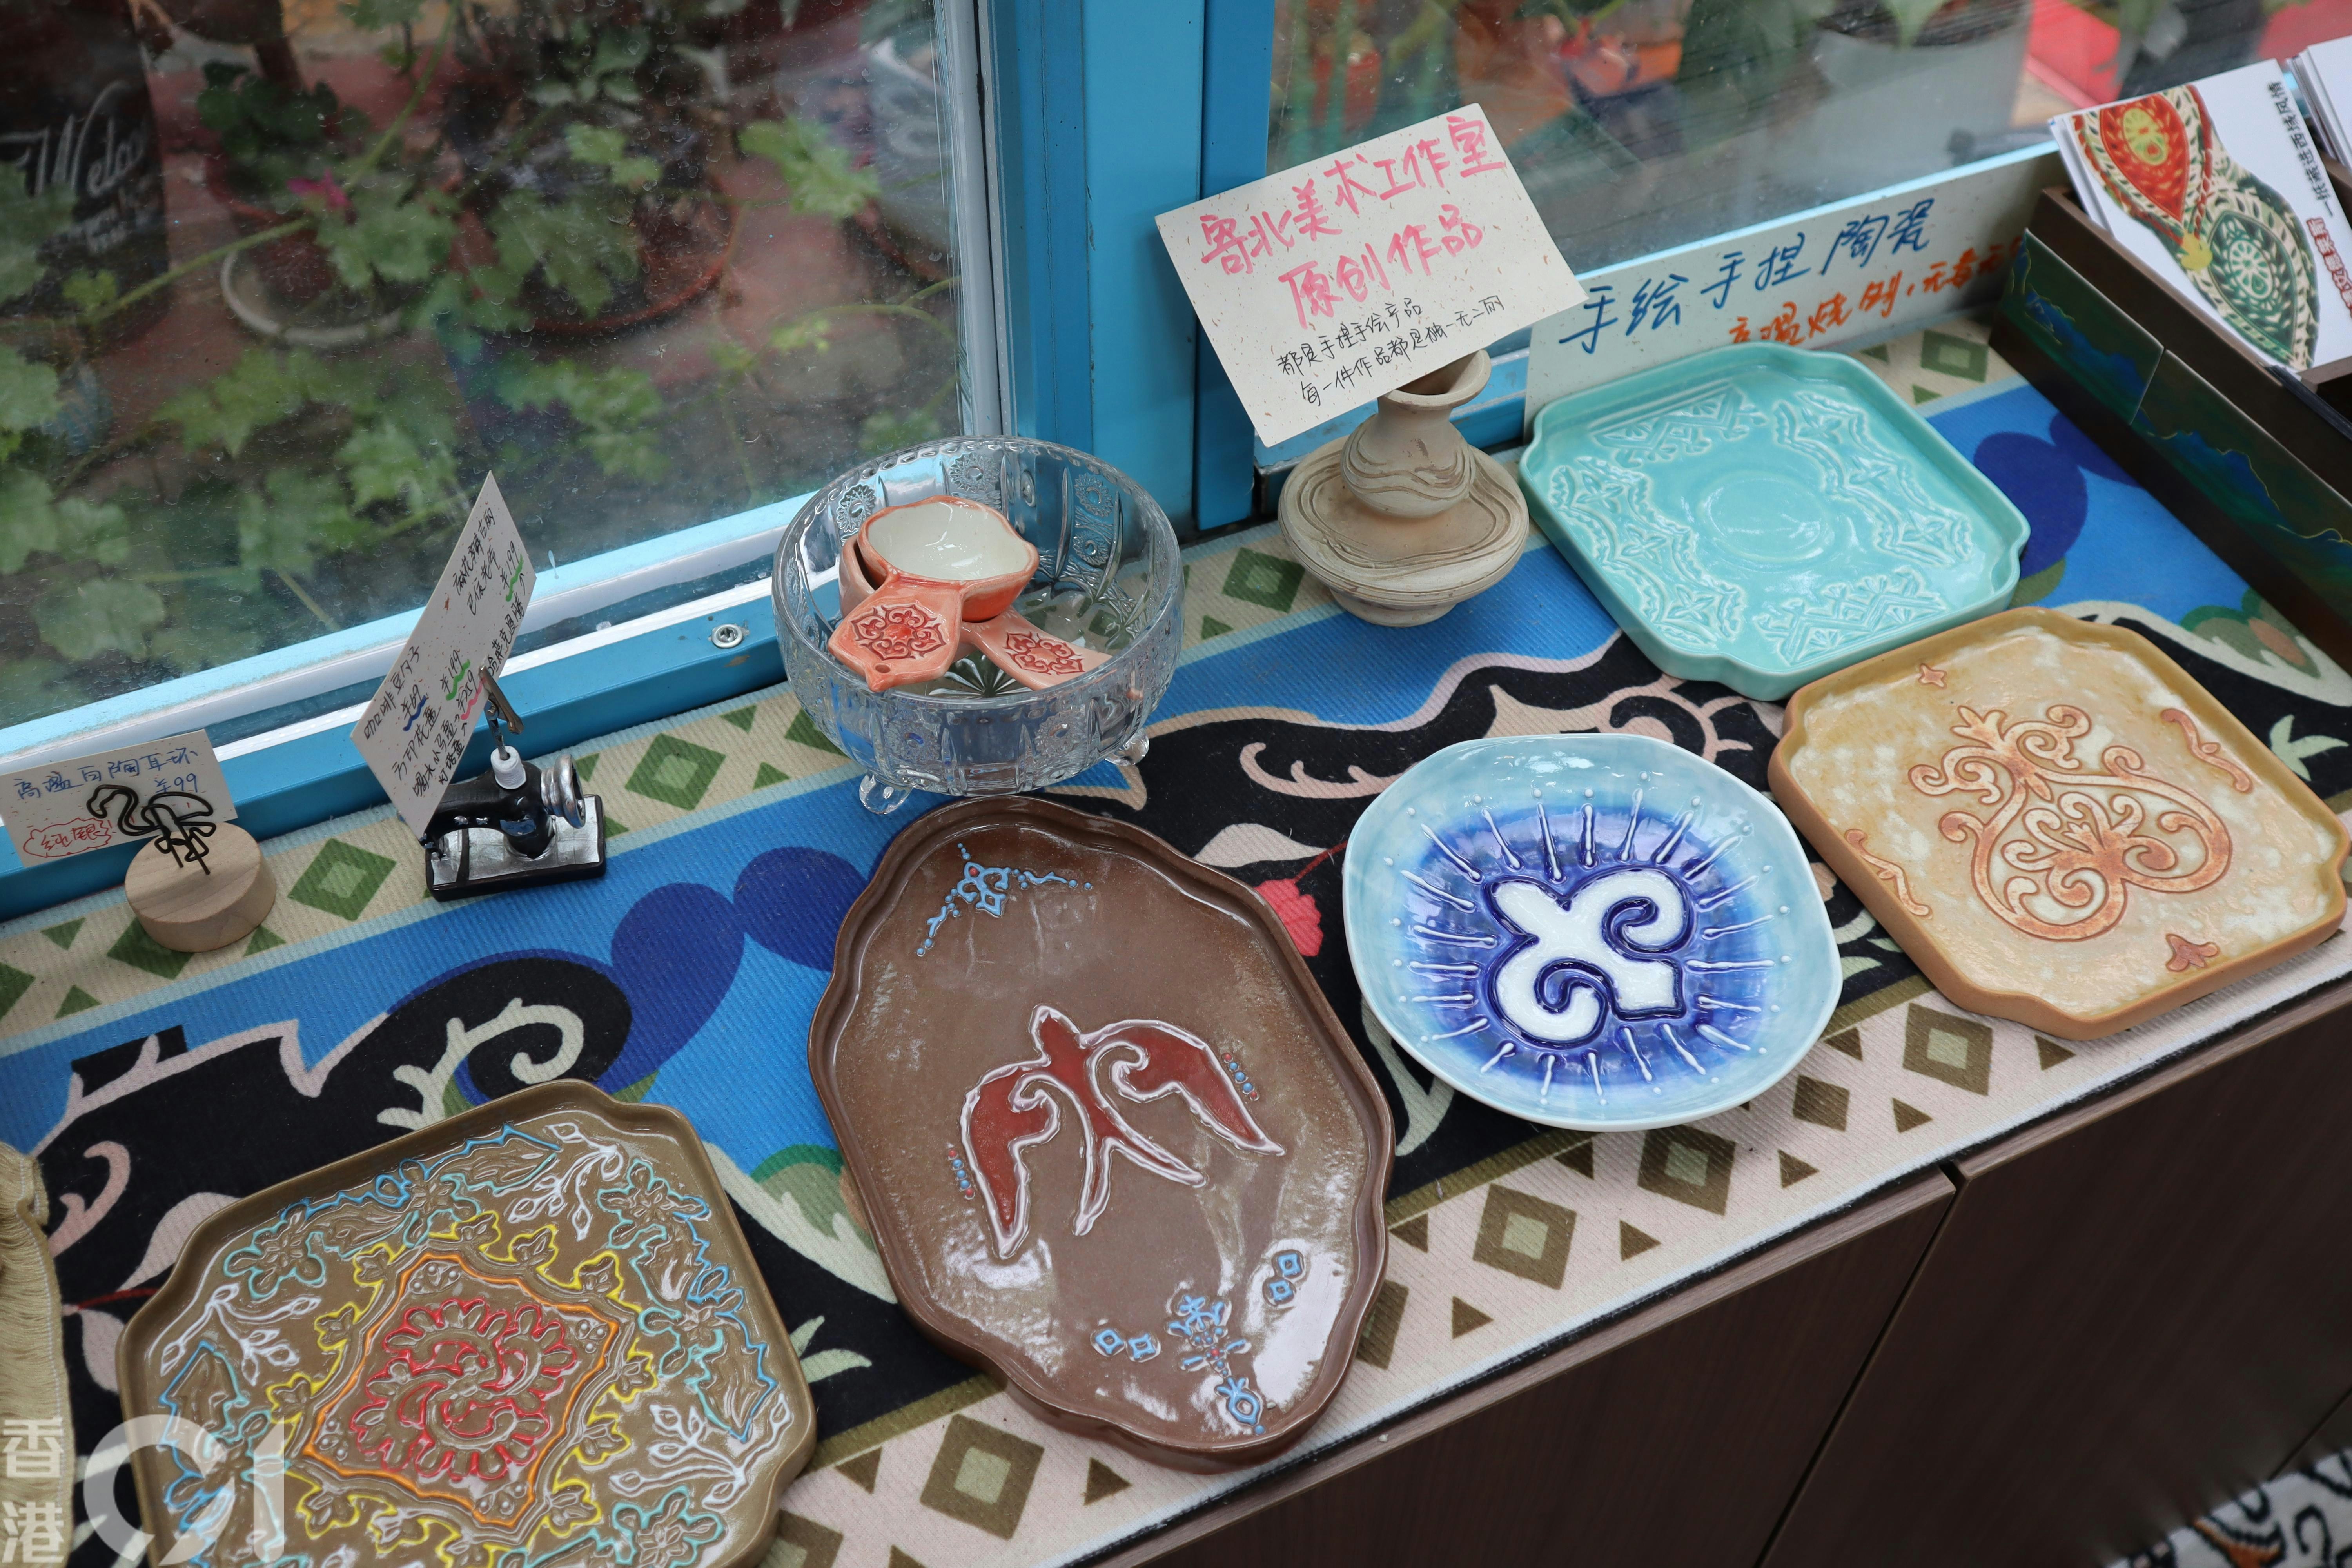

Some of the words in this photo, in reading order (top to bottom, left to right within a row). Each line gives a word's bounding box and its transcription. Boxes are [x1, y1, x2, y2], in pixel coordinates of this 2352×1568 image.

[1200, 115, 1507, 275] 寄北美术工作室
[1278, 203, 1484, 330] 原创作品
[1559, 198, 1935, 354] 手绘手捏陶瓷
[1276, 298, 1423, 376] 都是手捏手绘产品
[452, 507, 496, 596] 麻花辫古丽
[466, 544, 500, 616] 巴依老爷
[499, 540, 520, 591] ¥199
[487, 592, 524, 677] 哈萨克图腾
[363, 645, 420, 740] 咖啡豆勺子
[392, 706, 442, 781] 方印花盘
[440, 649, 464, 695] ¥199
[400, 684, 423, 720] ¥69
[456, 669, 477, 712] ¥259
[153, 773, 198, 794] ¥99
